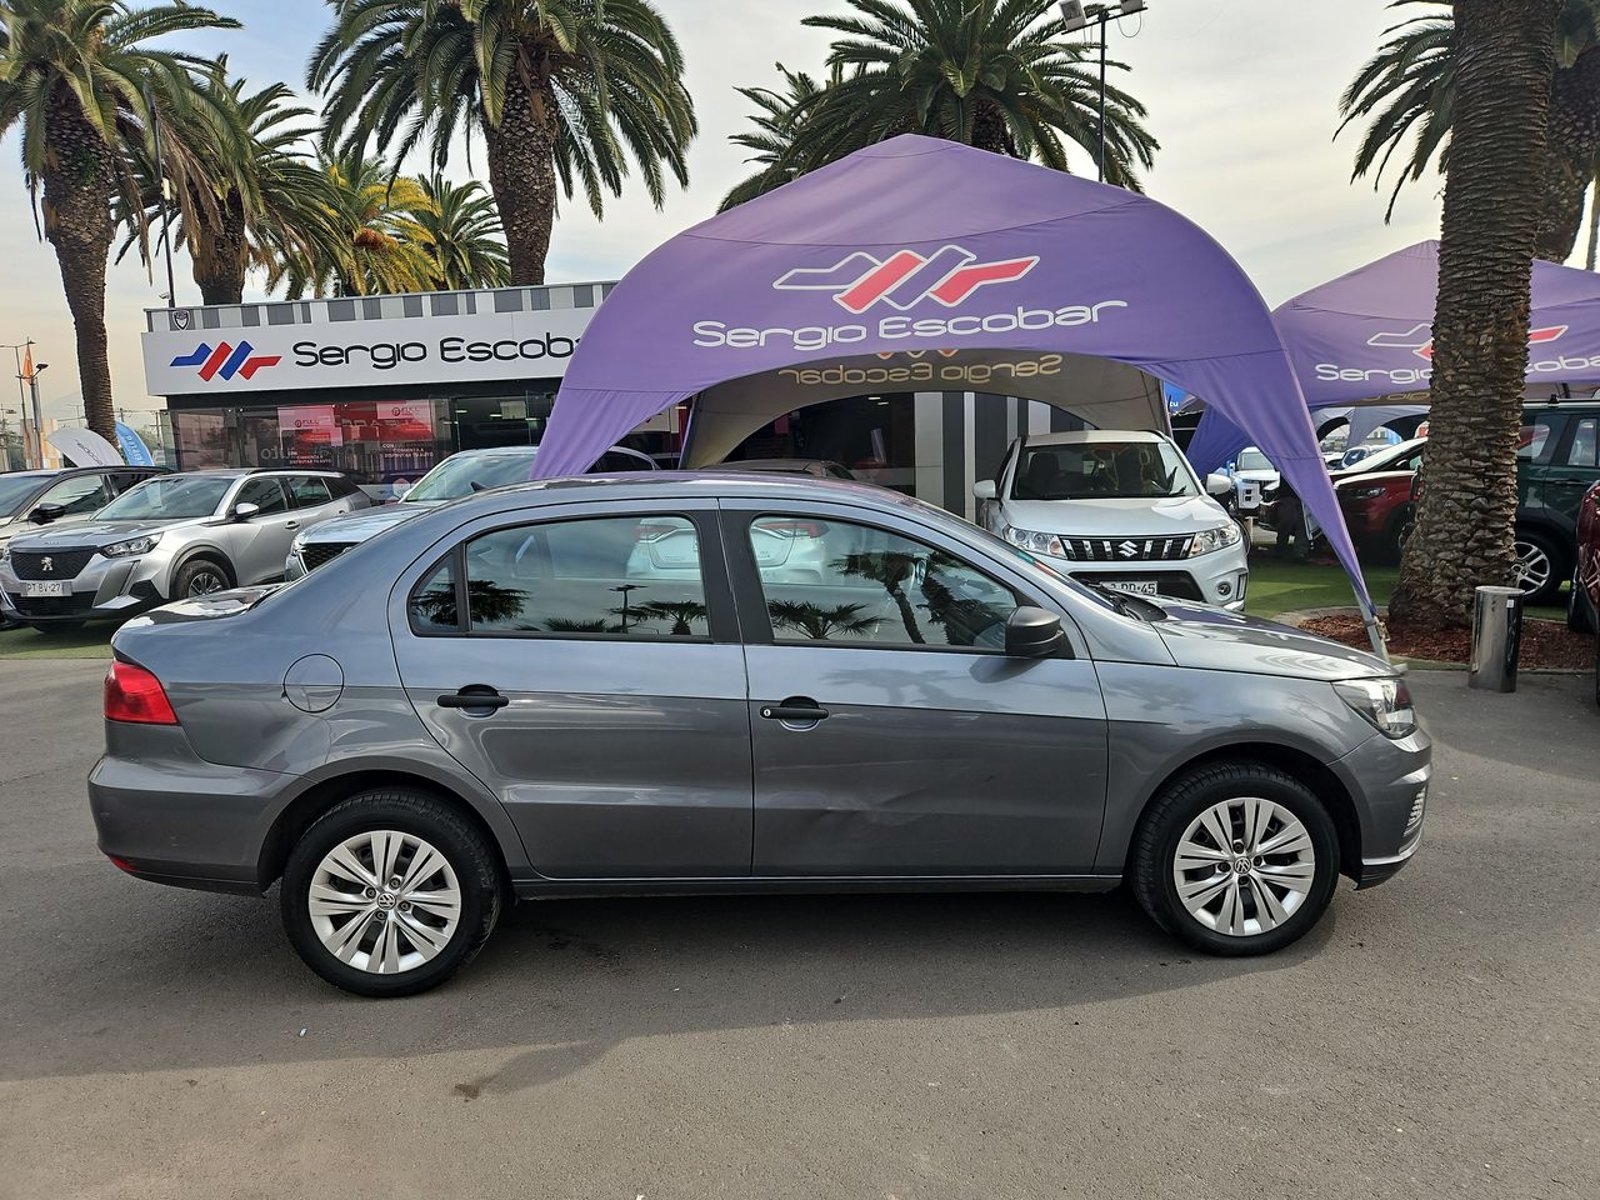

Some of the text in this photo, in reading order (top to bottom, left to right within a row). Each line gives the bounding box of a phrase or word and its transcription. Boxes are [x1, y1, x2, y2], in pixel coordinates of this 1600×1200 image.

[693, 300, 1128, 351] Sergio Escobar
[293, 341, 427, 369] Sergio
